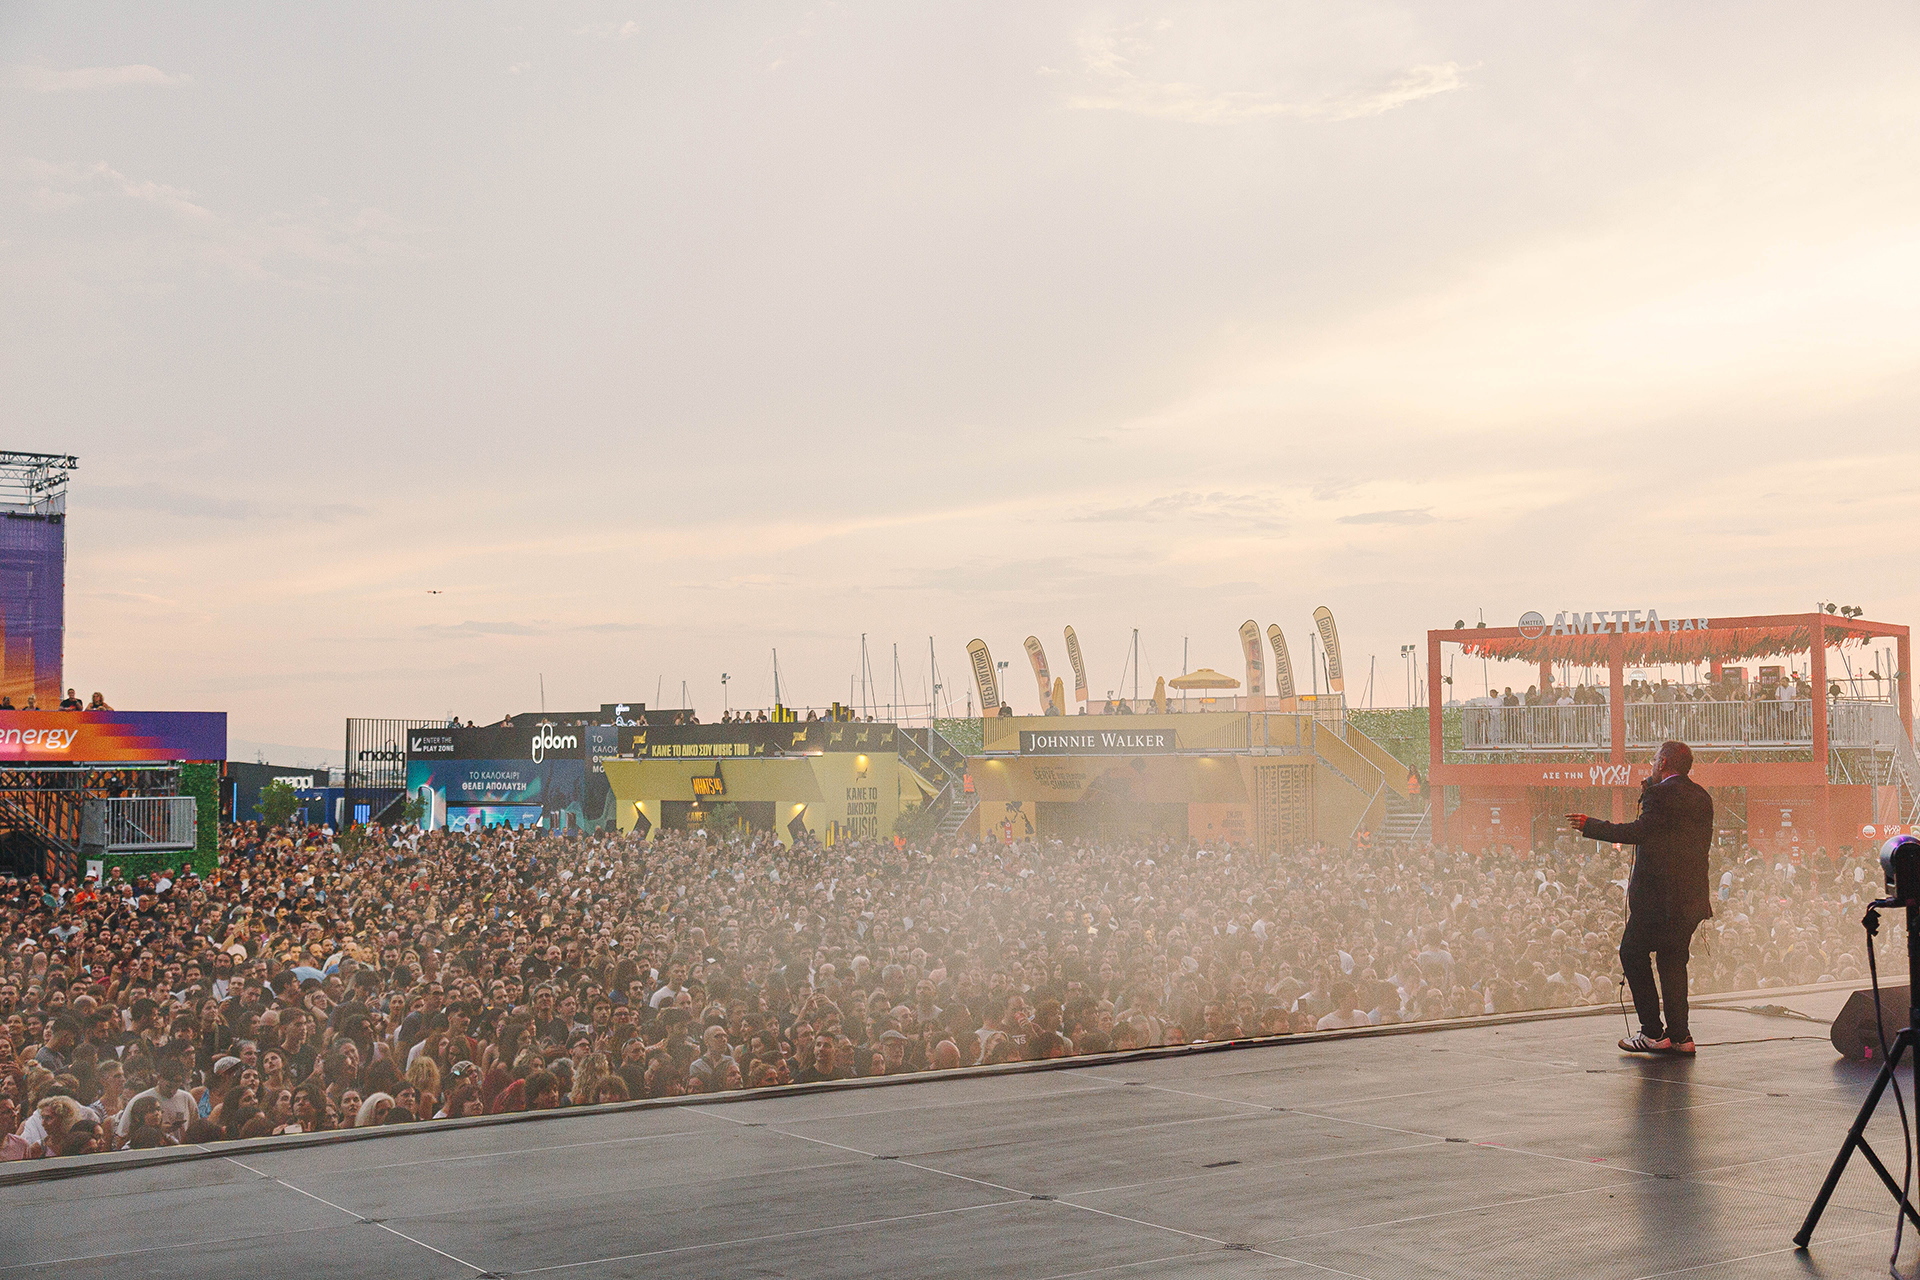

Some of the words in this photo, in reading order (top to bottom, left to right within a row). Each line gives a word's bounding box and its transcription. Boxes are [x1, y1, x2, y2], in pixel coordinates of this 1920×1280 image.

[1668, 617, 1709, 632] BAR
[423, 736, 440, 744] ENTER
[442, 736, 453, 744] THE
[531, 723, 578, 764] ploom
[592, 735, 604, 744] ΤΟ
[1029, 733, 1095, 751] JOHNNIE
[1101, 733, 1165, 747] WALKER
[438, 744, 455, 752] ZONE
[651, 745, 671, 757] ΚΑΝΕ
[672, 744, 682, 757] ΤΟ
[713, 743, 732, 756] MUSIC
[469, 771, 479, 780] ΤΟ
[1542, 771, 1560, 780] ΑΣΕ
[1564, 771, 1584, 780] ΤΗΝ
[1589, 764, 1632, 785] ΨΥΧΗ
[461, 782, 484, 791] ΘΕΛΕΙ
[485, 782, 527, 791] ΑΠΟΛΑΥΣΗ
[846, 787, 867, 801] ΚΑΝΕ
[868, 787, 878, 801] ΤΟ
[1280, 770, 1292, 836] WALKING
